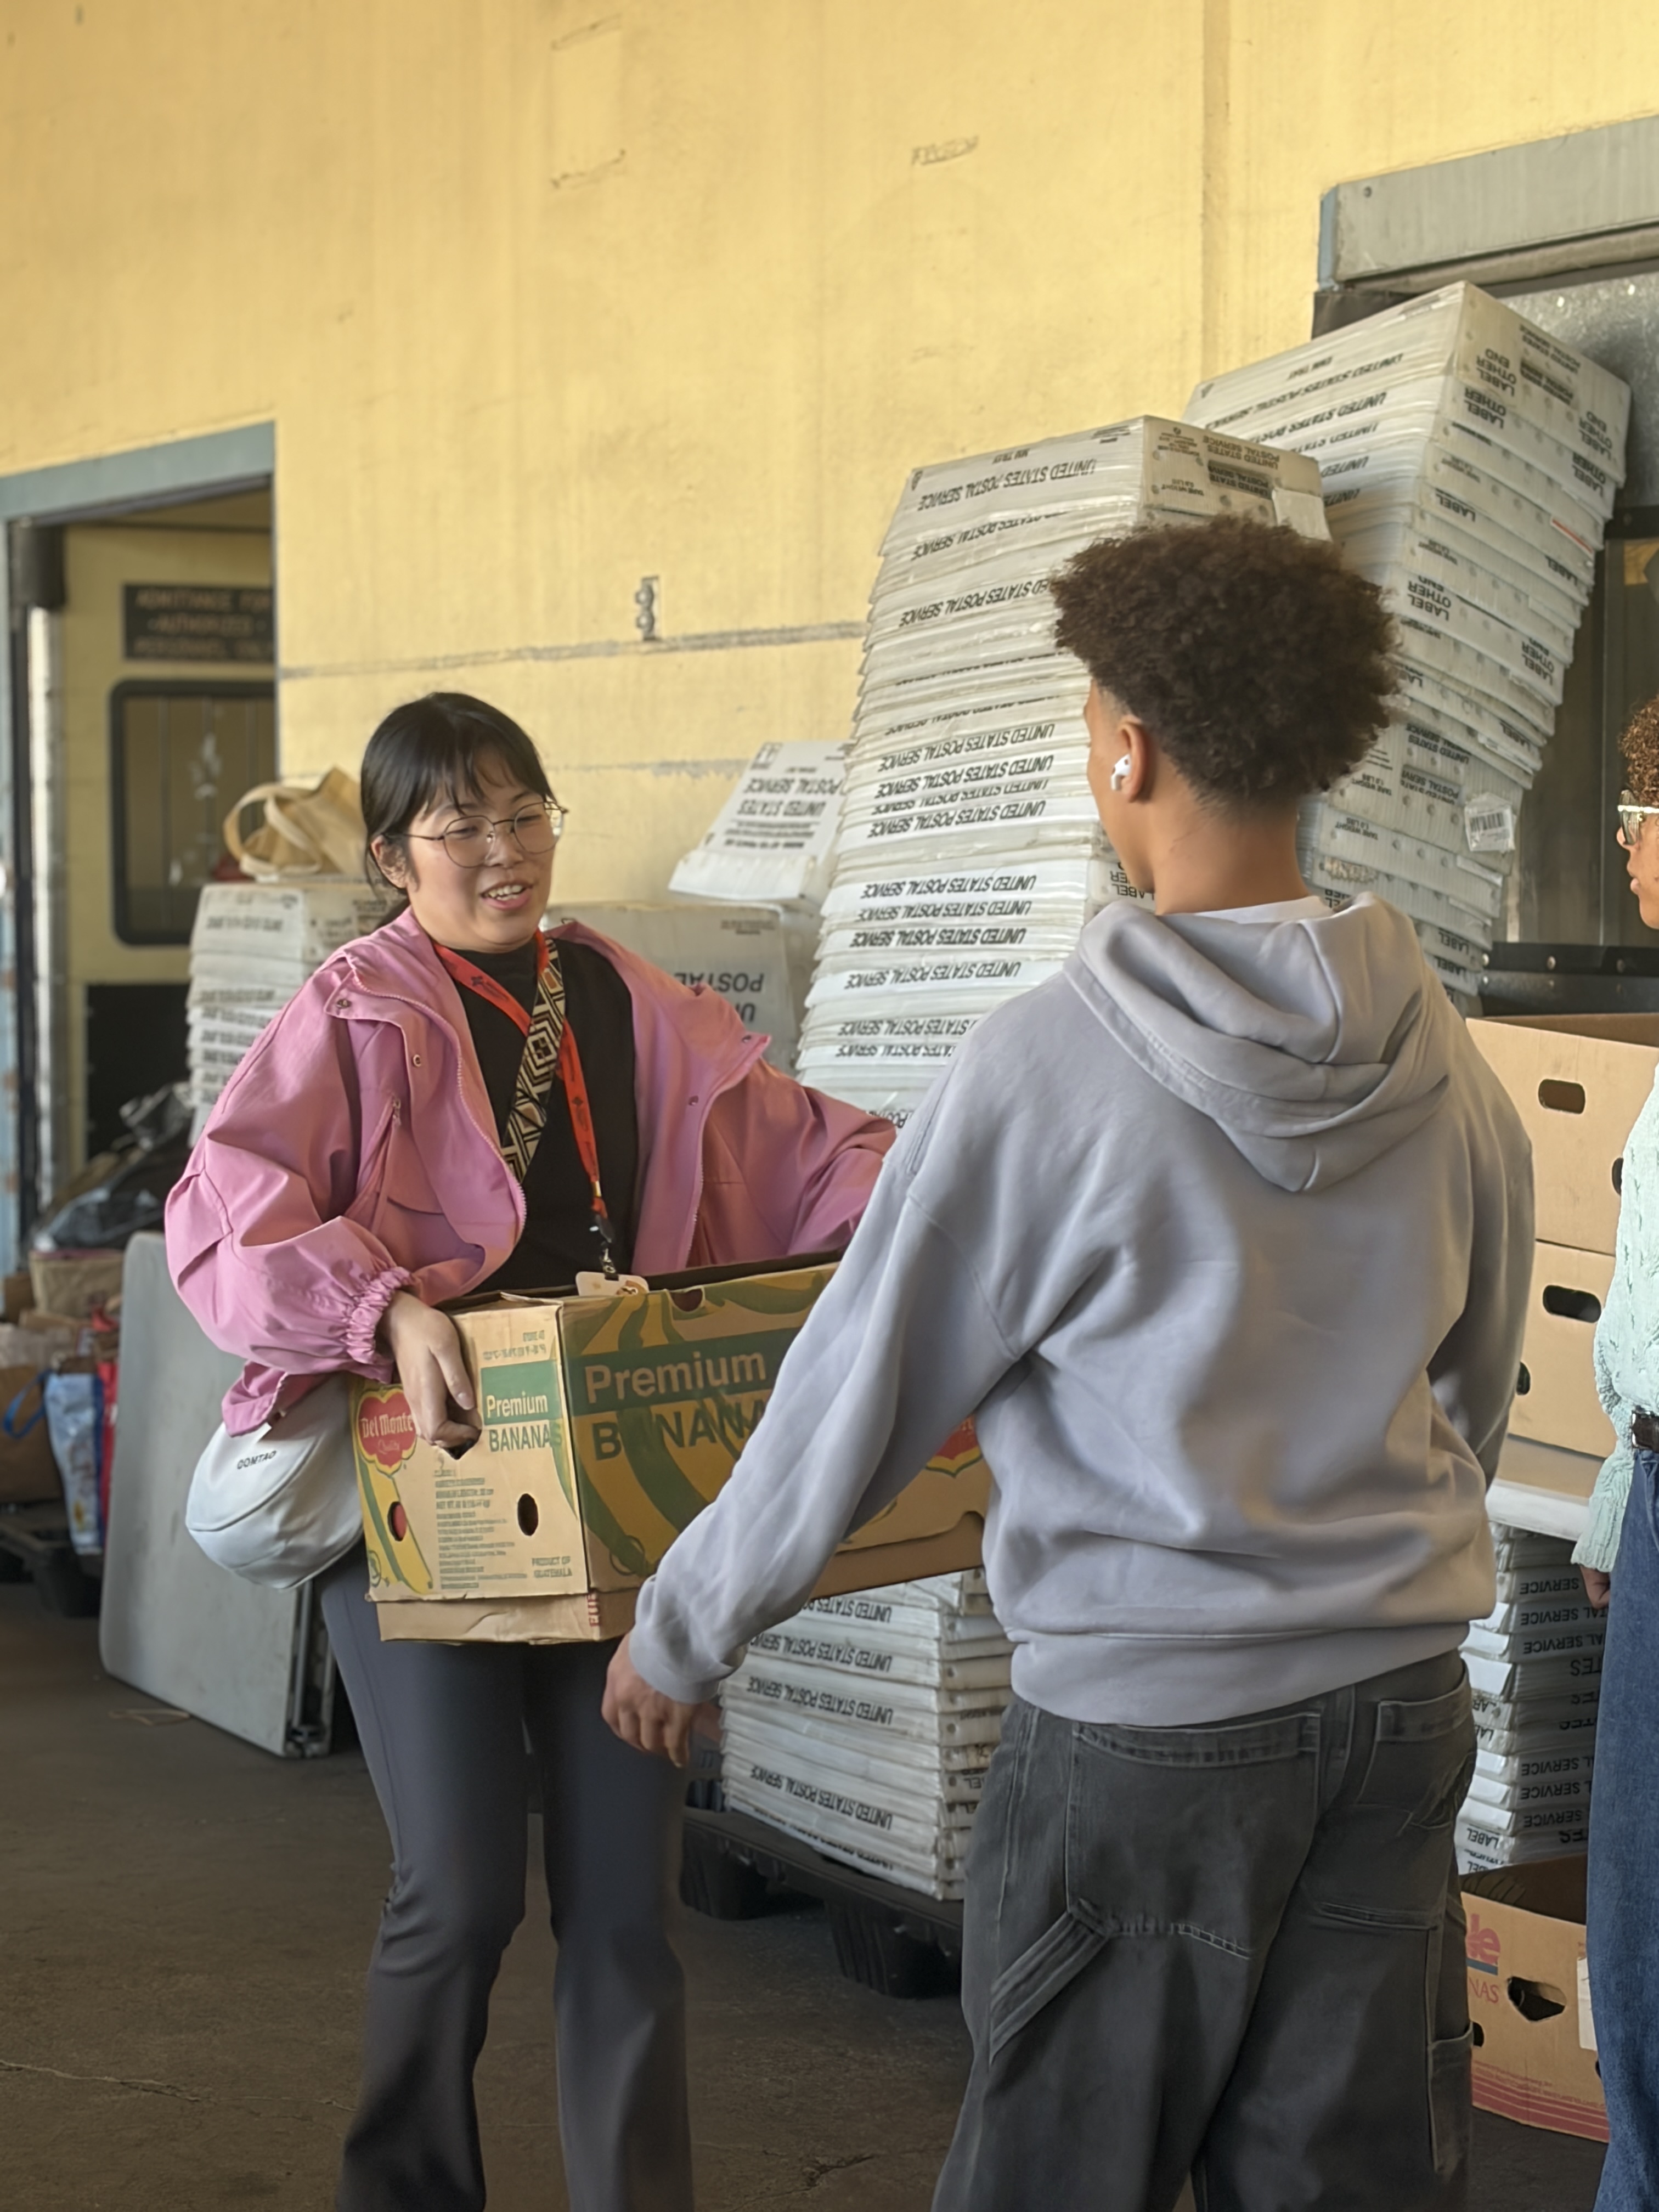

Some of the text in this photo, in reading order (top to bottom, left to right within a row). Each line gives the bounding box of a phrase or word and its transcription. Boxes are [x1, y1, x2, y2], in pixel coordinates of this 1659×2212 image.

[1476, 355, 1517, 385] OTHER
[1485, 347, 1510, 369] END
[1476, 367, 1516, 397] LABEL
[1337, 392, 1387, 417] UNITED
[1464, 387, 1507, 417] OTHER
[1464, 399, 1505, 430] LABEL
[1578, 416, 1613, 450] OTHER
[1586, 410, 1607, 433] END
[1202, 435, 1243, 453] SERVICE
[1244, 445, 1280, 463] POSTAL
[1578, 429, 1612, 461] LABEL
[1207, 444, 1279, 470] UNITED STATES
[1320, 456, 1370, 478] UNITED
[1572, 452, 1606, 485] OTHER
[917, 459, 1097, 512] UNITED STATES POSTAL SERVICE
[1209, 472, 1237, 487] STATE
[1572, 464, 1604, 498] LABEL
[1435, 493, 1476, 522] LABEL
[1544, 554, 1578, 586] LABEL
[945, 590, 987, 615] POSTAL
[986, 580, 1032, 605] STATES
[1408, 580, 1452, 608] OTHER
[899, 601, 945, 628] SERVICE
[1407, 594, 1450, 622] LABEL
[1521, 640, 1555, 674] OTHER
[1522, 653, 1554, 686] LABEL
[964, 730, 1011, 752] STATES
[1011, 723, 1056, 744] UNITED
[1407, 734, 1440, 754] STATES
[1499, 720, 1532, 752] LABEL
[878, 747, 923, 773] SERVICE
[923, 738, 965, 761] POSTAL
[1440, 746, 1470, 765] UNITED
[874, 754, 1054, 800] UNITED STATES POSTAL SERVICE
[1401, 770, 1460, 798] POSTAL SERVI
[1376, 785, 1392, 796] TARE
[867, 800, 1047, 839] UNITED STATES POSTAL SERVICE
[1335, 821, 1379, 840] TARE WEIGHT
[860, 874, 1037, 899] UNITED STATES POSTAL SERVICE
[855, 900, 1032, 923] UNITED STATES POSTAL SERVICE
[849, 927, 1027, 948] UNITED STATES POSTAL SERVICE
[1437, 930, 1470, 955] LABEL
[843, 961, 1022, 990] UNITED STATES POSTAL SERVICE
[1433, 955, 1468, 975] LABEL
[837, 1019, 969, 1036] STATES POSTAL SERVICE
[584, 1351, 766, 1404] Premium
[485, 1391, 549, 1419] Premium
[360, 1412, 414, 1438] Del Monte
[489, 1420, 562, 1452] BANANAS
[1519, 1577, 1580, 1595] SERVICE
[855, 1601, 893, 1624] UNITED
[1520, 1607, 1579, 1626] SERVICE
[782, 1635, 893, 1673] UNITED STATES POSTAL
[1523, 1635, 1583, 1655] SERVICE
[747, 1676, 894, 1725] UNITED STATES POSTAL SERVICE
[1521, 1757, 1579, 1776] SERVICE
[750, 1765, 893, 1831] UNITED STATES POSTAL SERVICE
[1520, 1782, 1581, 1801] SERVICE
[1523, 1810, 1582, 1828] SERVICE
[1466, 1826, 1500, 1849] LABEL
